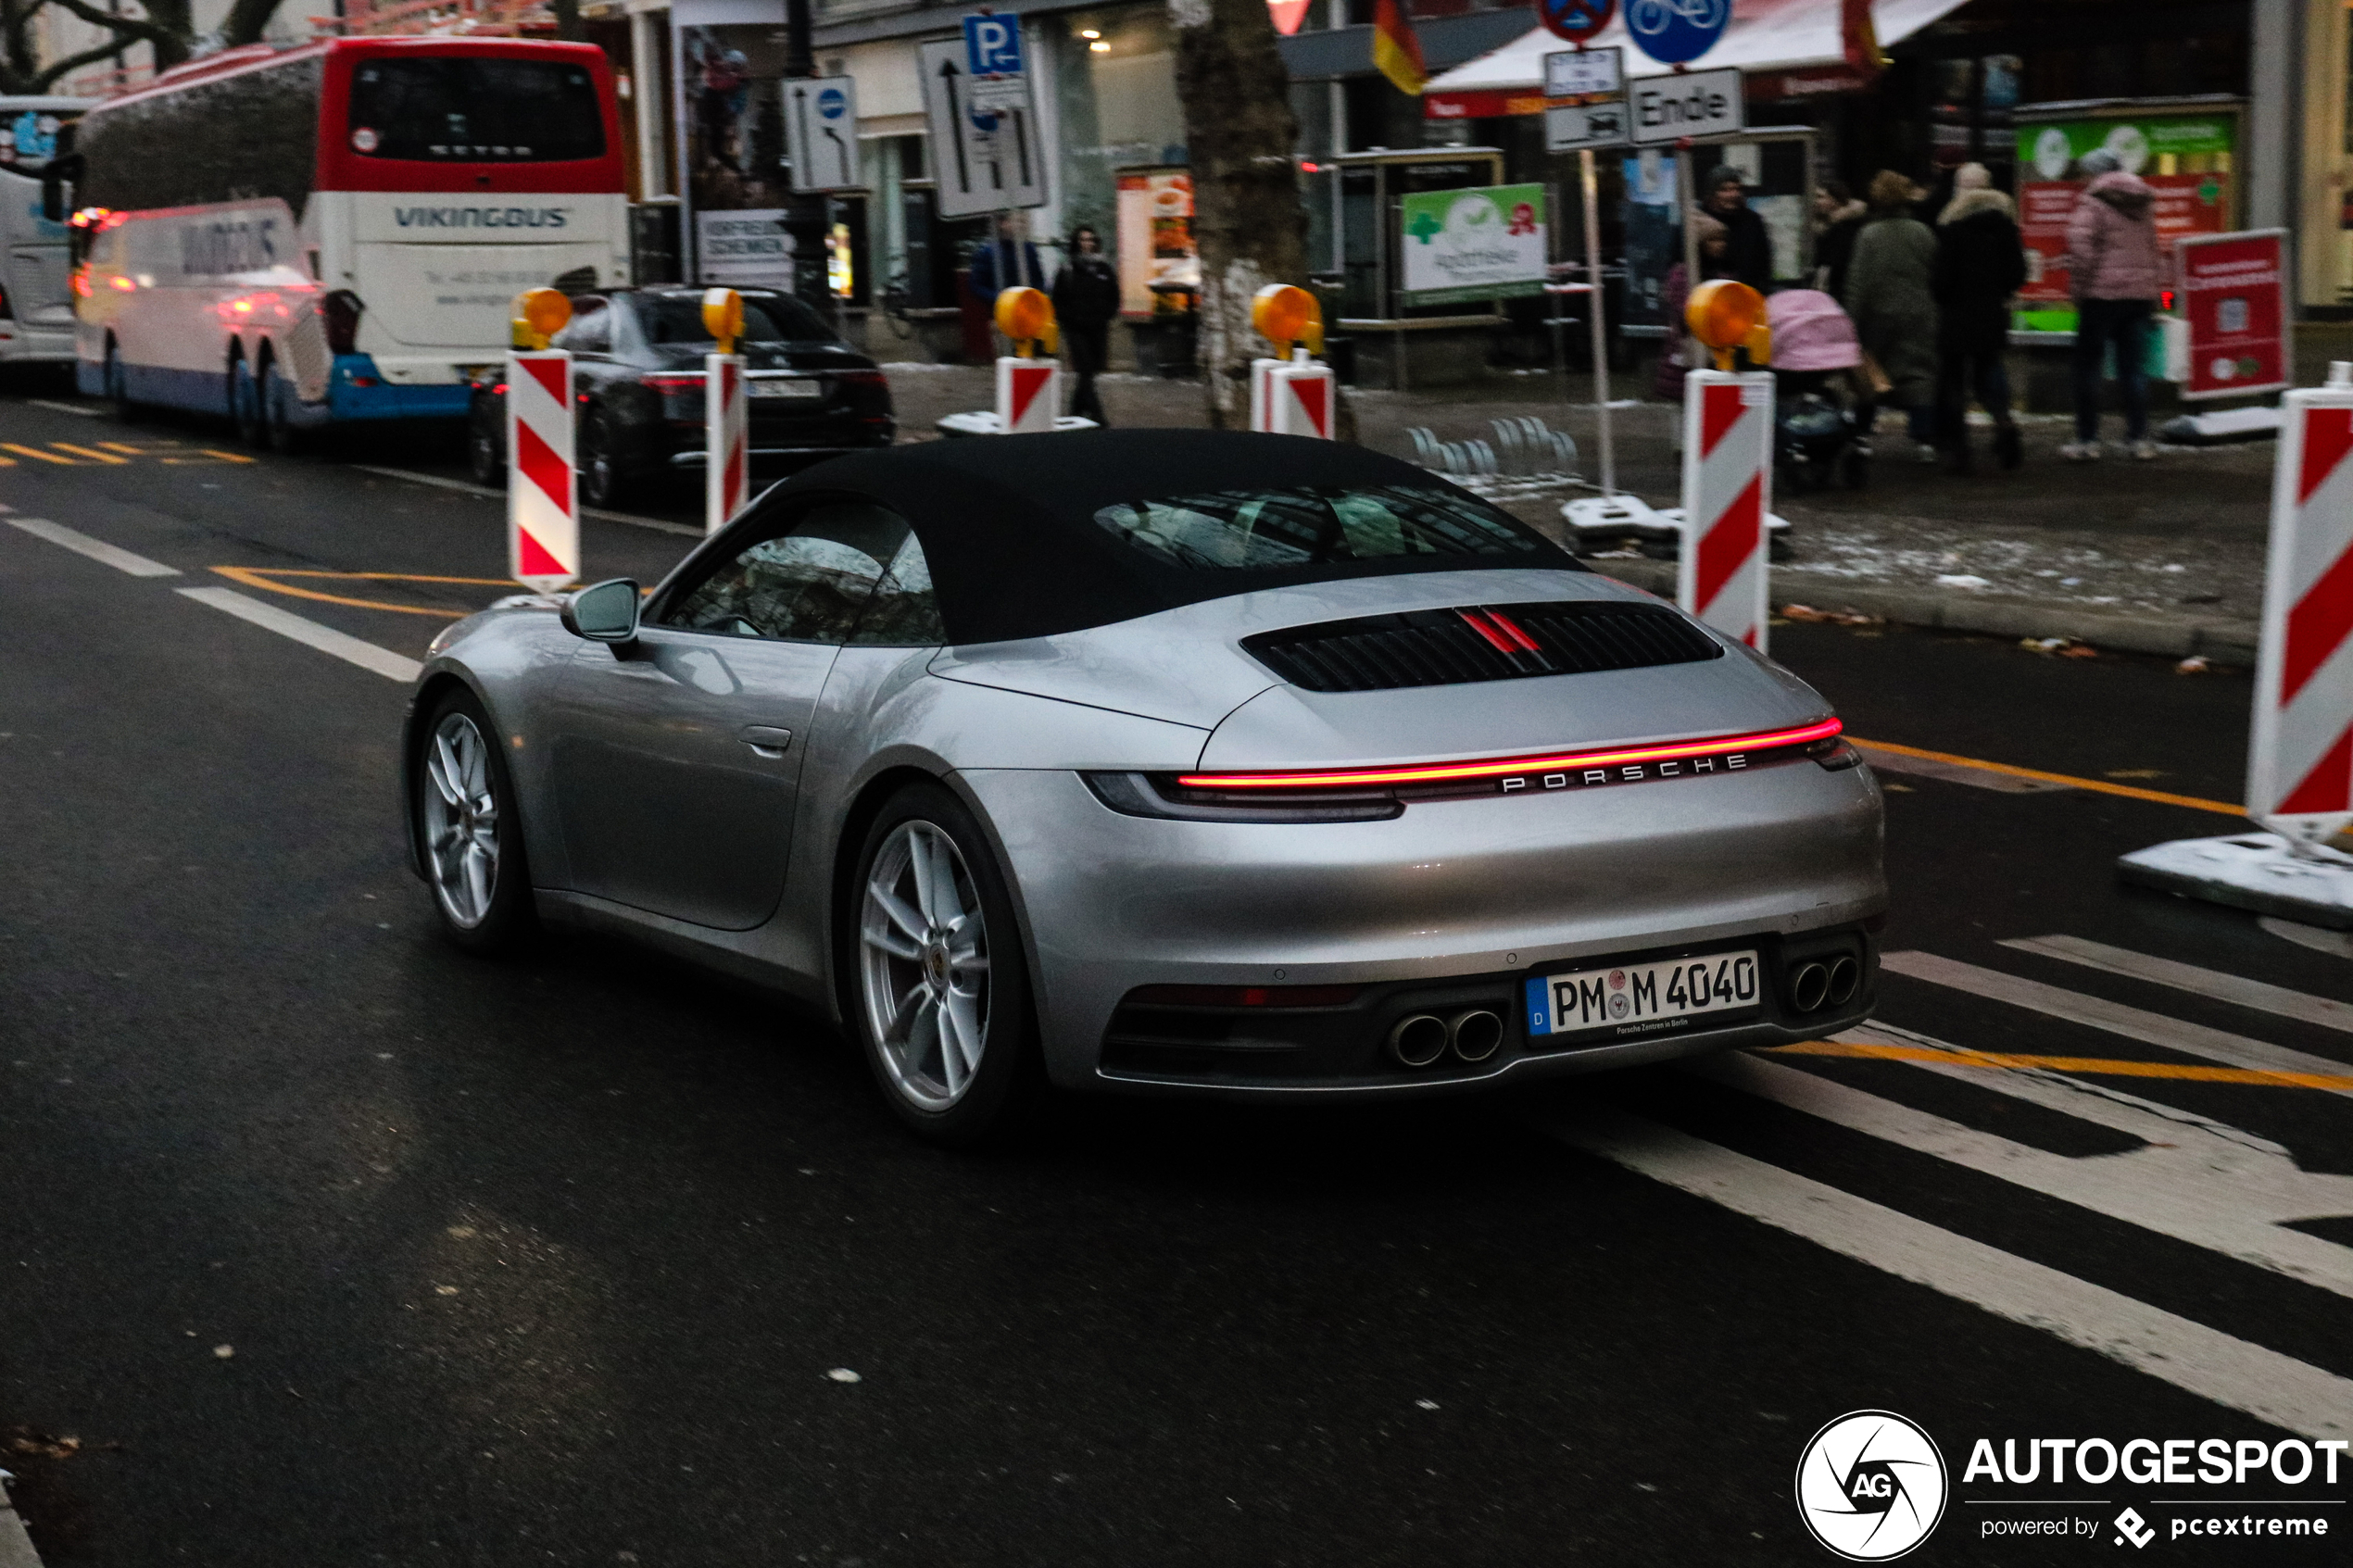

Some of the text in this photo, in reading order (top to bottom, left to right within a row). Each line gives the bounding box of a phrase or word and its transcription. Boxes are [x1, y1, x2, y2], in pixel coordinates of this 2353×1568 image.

[975, 21, 1008, 67] P
[1640, 86, 1727, 126] Ende
[394, 206, 568, 228] VIKINGBUS
[1502, 754, 1747, 793] PORSCHE
[1533, 957, 1756, 1026] D PM M 4040
[1617, 1025, 1642, 1035] Porsche
[1642, 1022, 1665, 1032] Zentren
[1671, 1019, 1689, 1028] Berlin
